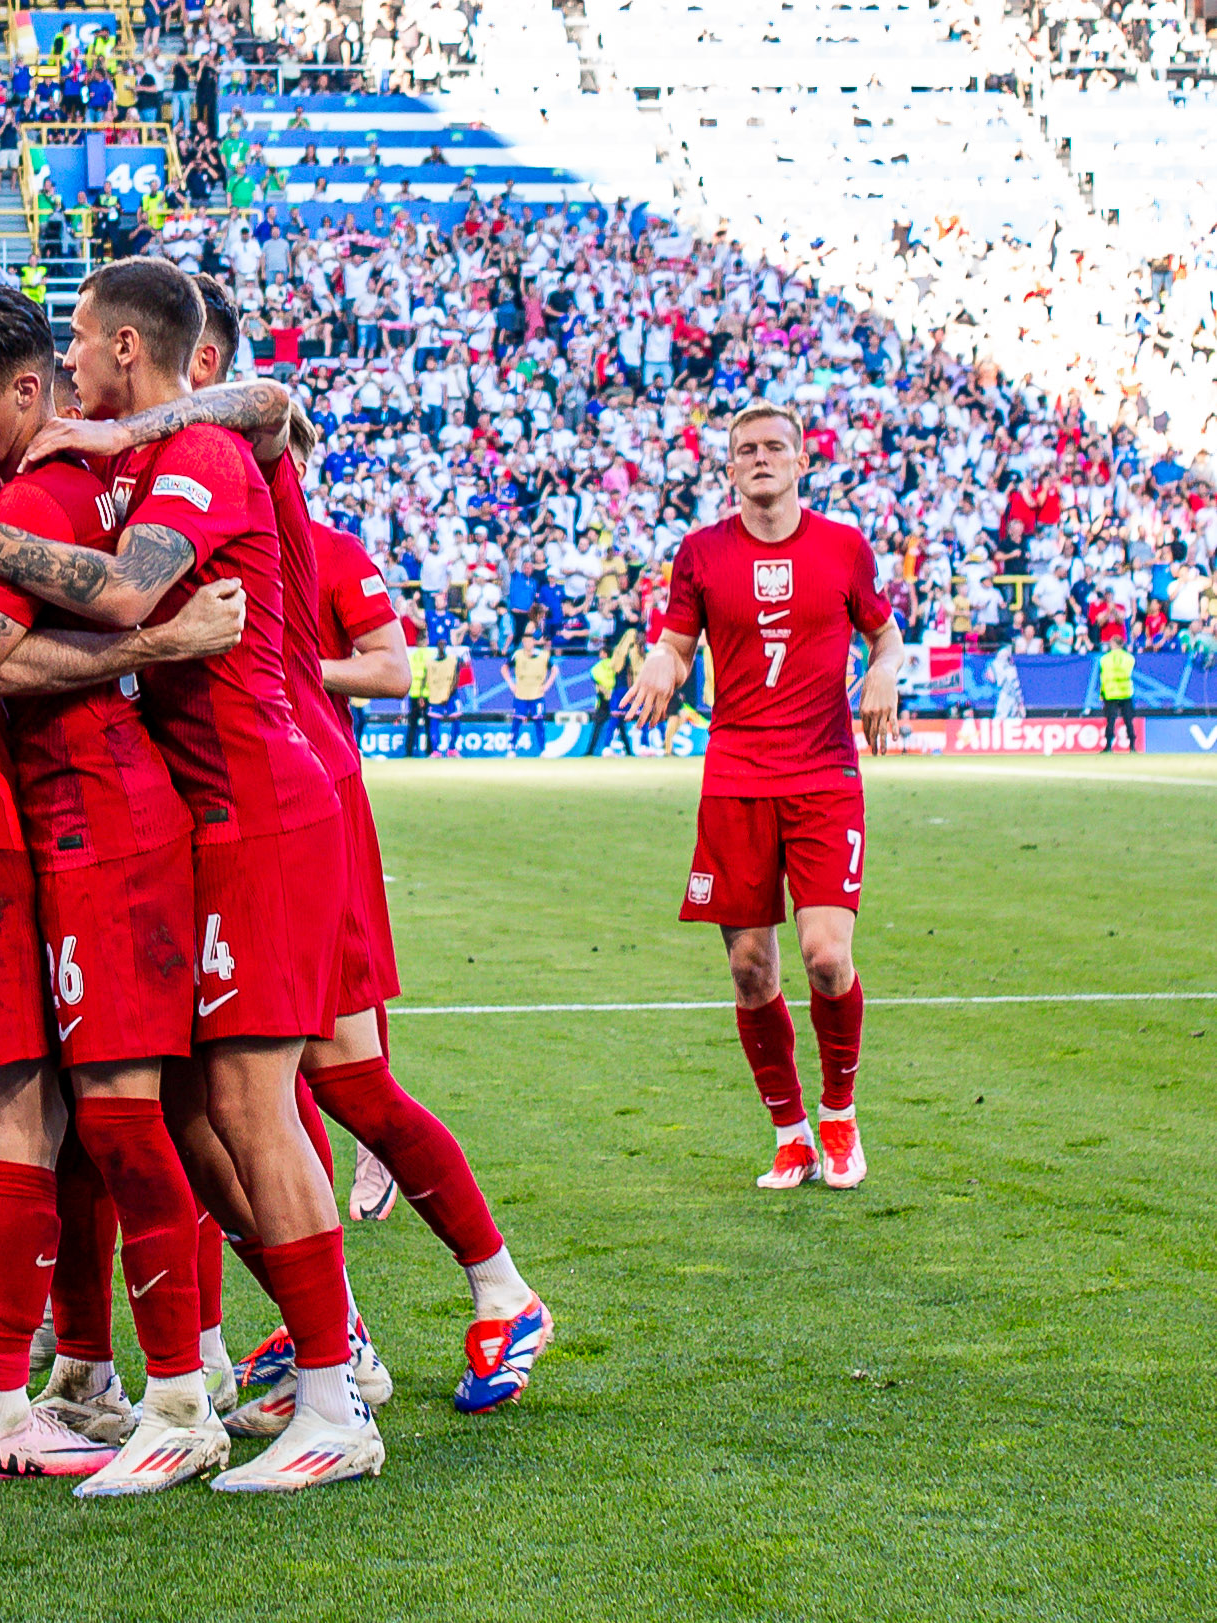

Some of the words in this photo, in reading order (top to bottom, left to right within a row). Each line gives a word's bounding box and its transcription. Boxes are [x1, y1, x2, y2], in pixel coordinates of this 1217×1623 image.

[106, 164, 161, 194] 46
[764, 642, 786, 687] 7
[360, 732, 405, 752] UEF
[847, 829, 862, 874] 7
[194, 913, 235, 985] 4
